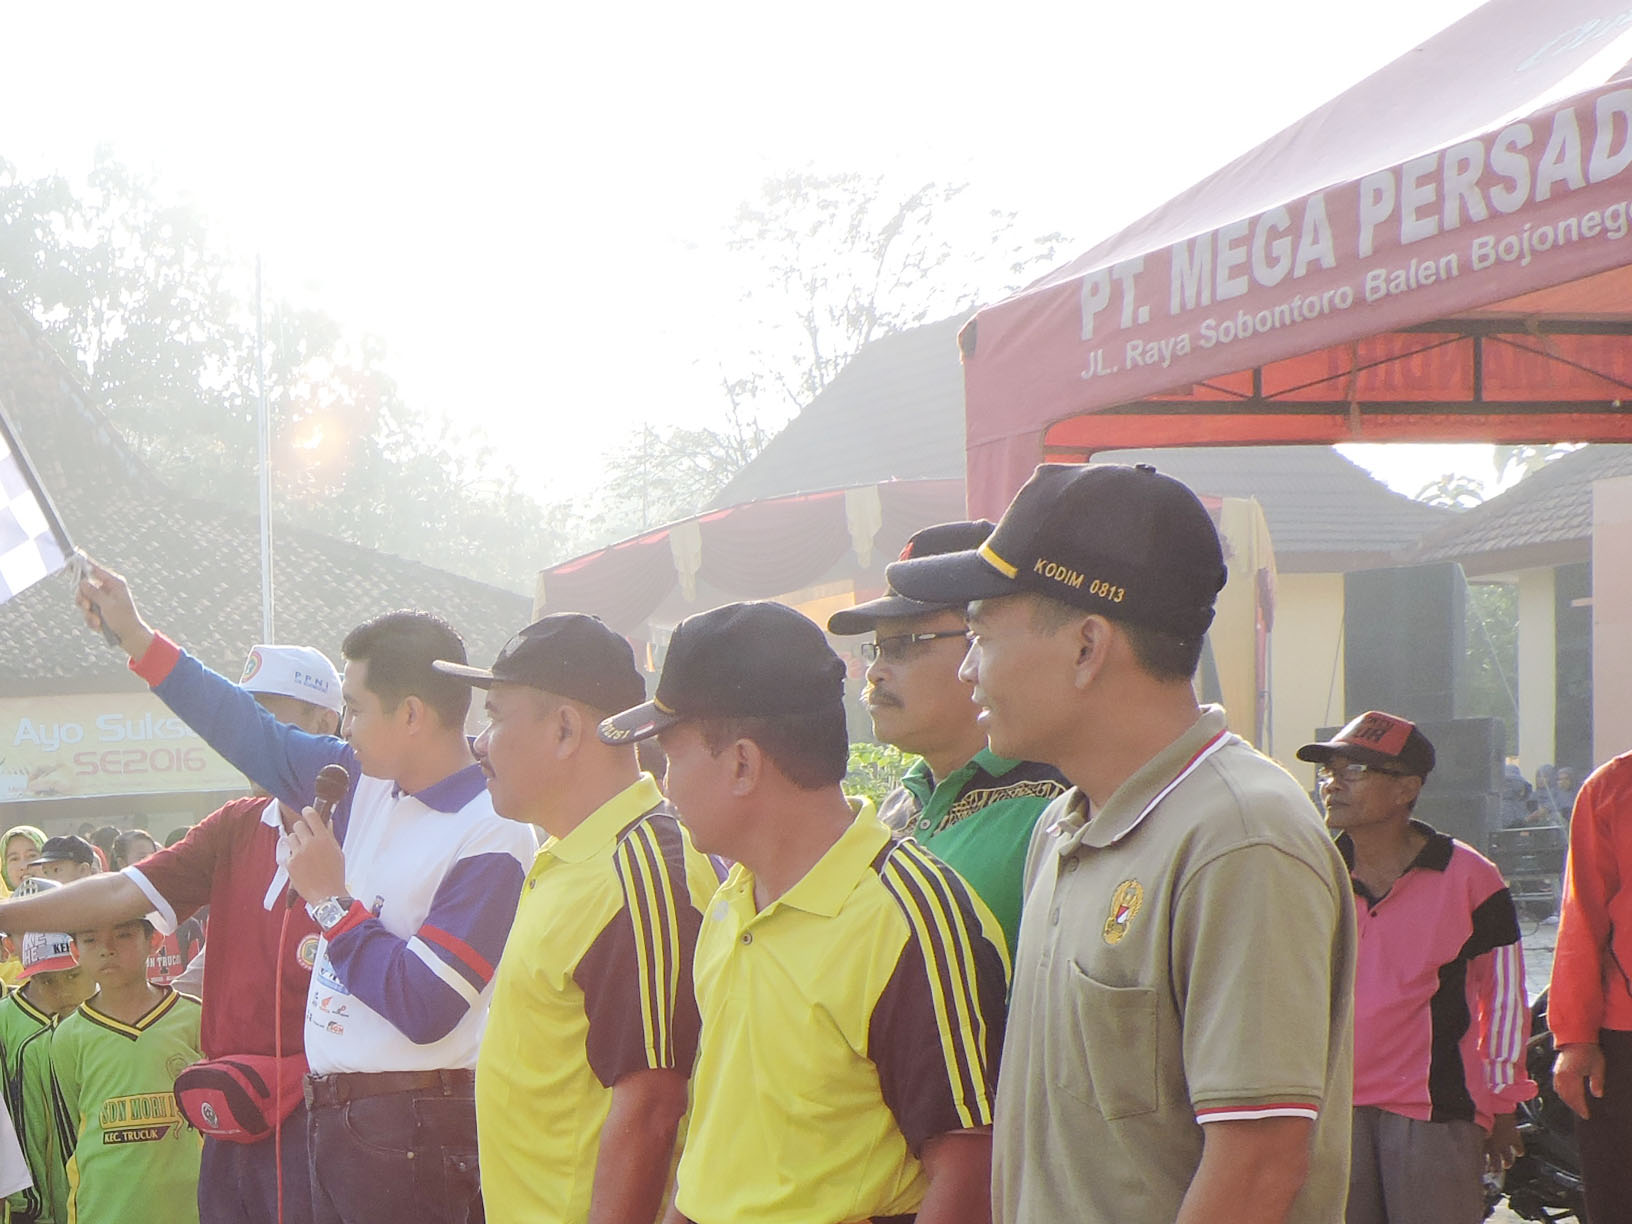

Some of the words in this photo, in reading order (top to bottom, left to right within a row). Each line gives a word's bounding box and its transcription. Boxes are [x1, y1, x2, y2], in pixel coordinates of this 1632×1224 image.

[1080, 347, 1118, 381] JL.
[1125, 330, 1191, 370] Raya
[1199, 284, 1354, 349] Sobontoro
[1364, 251, 1460, 303] Balen
[1470, 197, 1632, 271] Bojoneg
[1081, 257, 1150, 341] PT.
[1169, 203, 1336, 315] MEGA
[1033, 558, 1085, 589] KODIM
[1089, 579, 1126, 603] 0813
[11, 717, 84, 752] Ayo
[73, 747, 207, 776] SE2016
[101, 1099, 127, 1124] SDN
[104, 1130, 121, 1143] KEC.
[123, 1128, 159, 1142] TRUCUK
